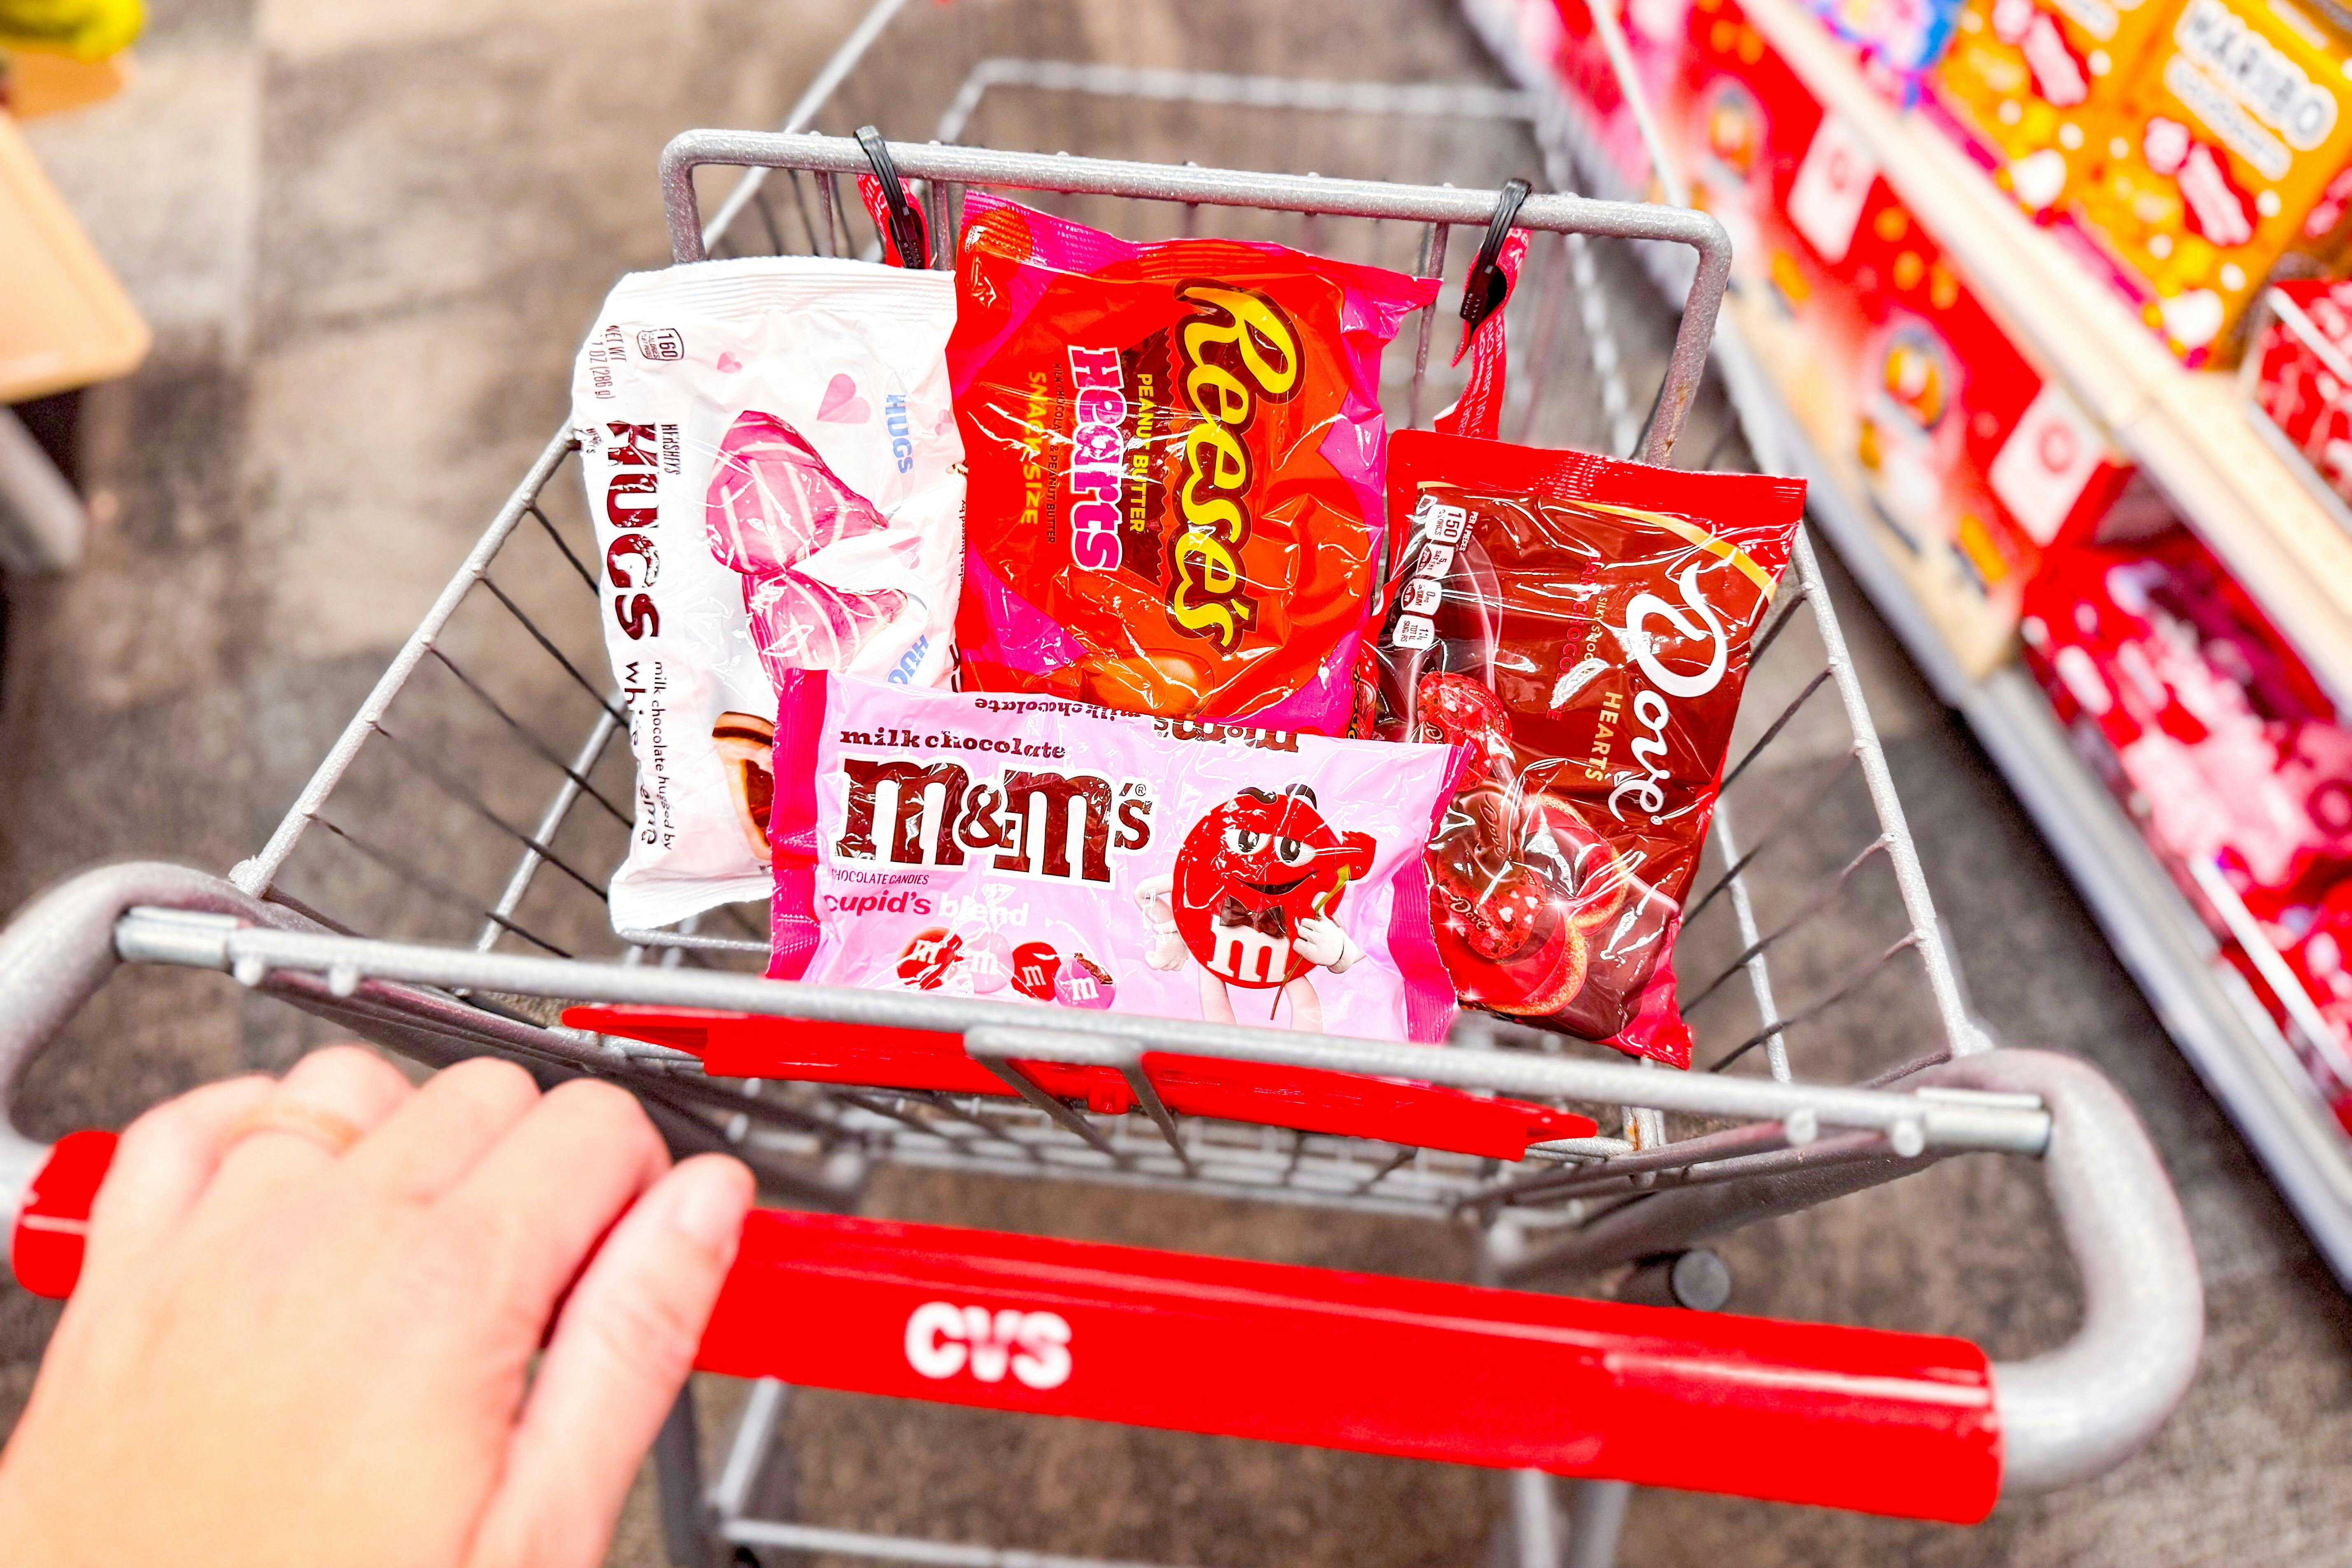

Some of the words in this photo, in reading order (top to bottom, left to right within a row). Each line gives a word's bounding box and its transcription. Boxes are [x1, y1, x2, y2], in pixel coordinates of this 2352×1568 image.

[657, 334, 679, 358] 160
[1131, 373, 1154, 449] PEANUT
[884, 393, 913, 474] HUGS
[1174, 285, 1297, 649] Reese's
[1020, 463, 1043, 525] SIZE
[1128, 453, 1149, 534] BUTTER
[1045, 504, 1057, 544] BUTTER
[1443, 510, 1463, 538] 150
[1468, 511, 1479, 525] PER
[1458, 530, 1472, 552] PIECES
[1580, 551, 1603, 595] DAR
[1594, 597, 1608, 621] SILKY
[653, 661, 667, 695] milk
[887, 635, 929, 684] HUG
[1608, 560, 1729, 823] Dove
[651, 700, 667, 772] chocolate
[840, 728, 921, 749] milk
[925, 730, 1066, 759] chocolate
[1584, 691, 1623, 782] HEARTS
[664, 833, 676, 851] by
[831, 868, 889, 885] CHOCOLATE
[889, 874, 929, 885] CANDIES
[824, 889, 931, 917] cupid's
[938, 892, 1029, 927] blend
[1449, 898, 1486, 931] Dove
[1207, 915, 1292, 983] m
[1021, 964, 1048, 987] m
[1070, 976, 1099, 1001] m
[904, 1301, 1073, 1390] CVS
